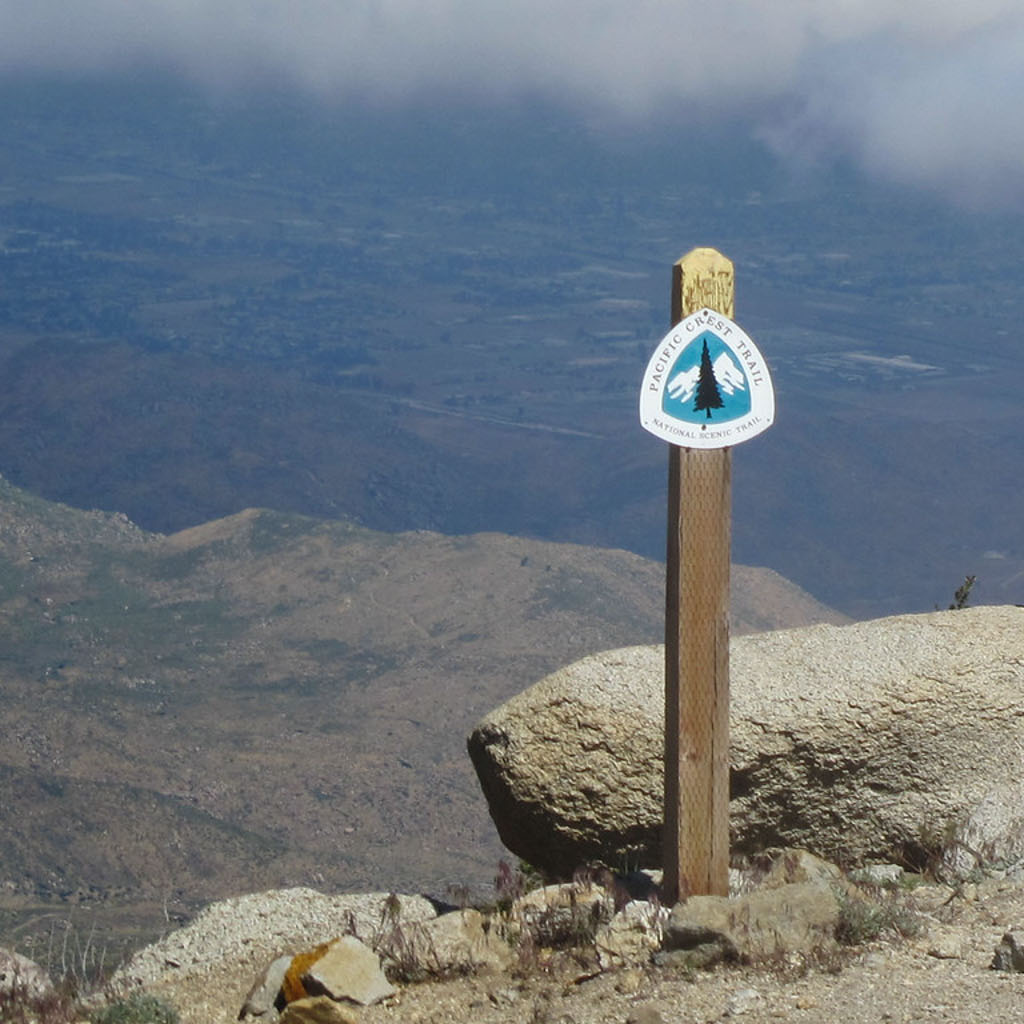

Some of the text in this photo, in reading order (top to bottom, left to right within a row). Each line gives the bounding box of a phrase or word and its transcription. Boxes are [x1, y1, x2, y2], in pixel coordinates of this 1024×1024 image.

[649, 315, 764, 392] PACIFIC CREST TRAIL
[652, 415, 763, 440] NATIONAL SCENIC TRAIL
